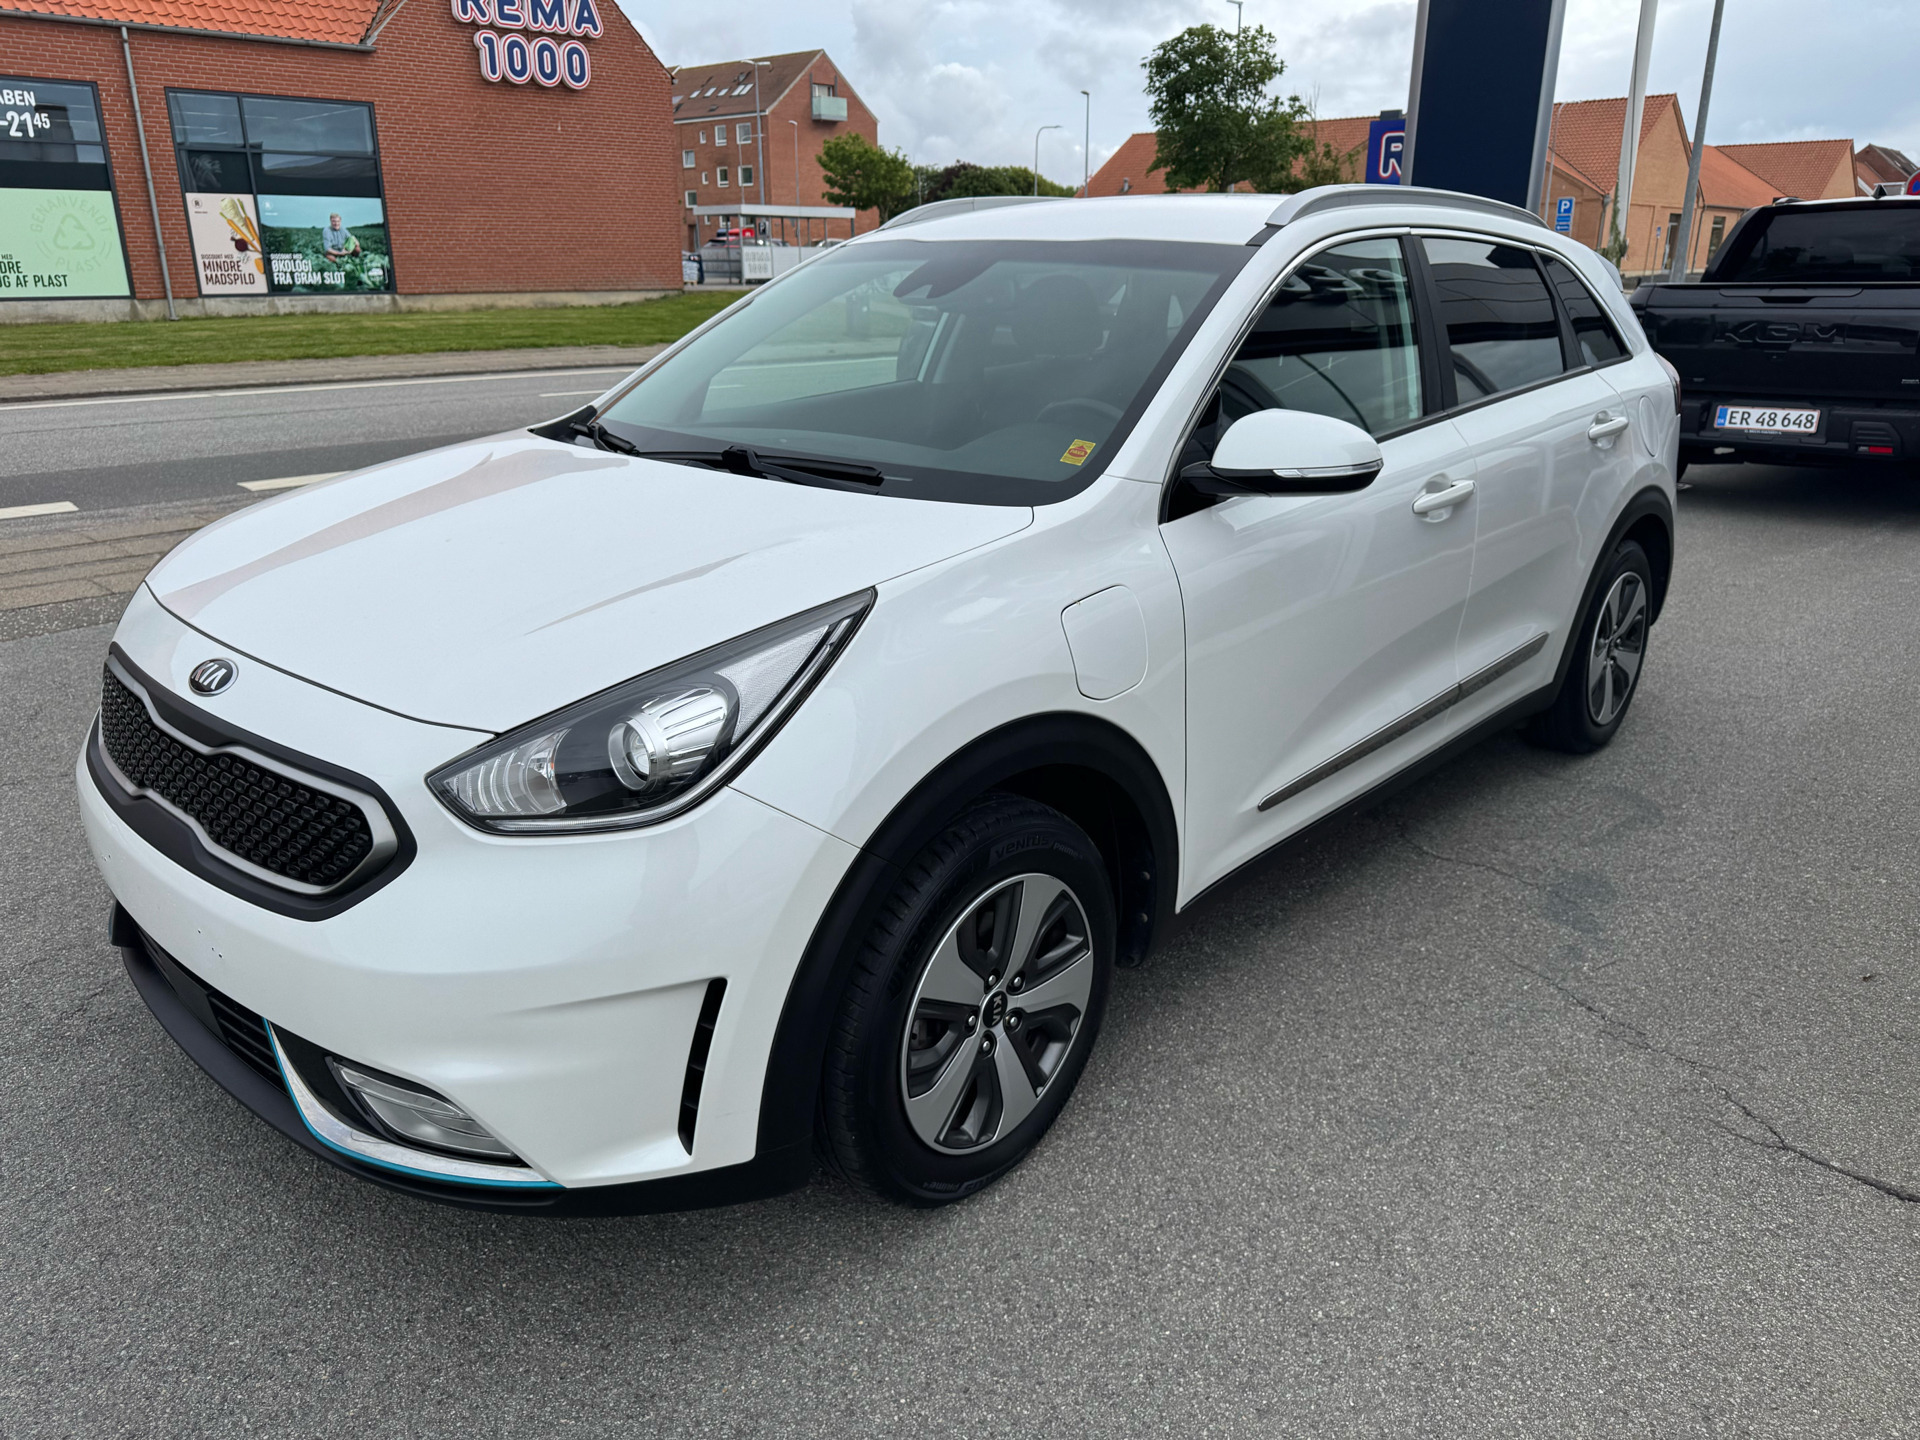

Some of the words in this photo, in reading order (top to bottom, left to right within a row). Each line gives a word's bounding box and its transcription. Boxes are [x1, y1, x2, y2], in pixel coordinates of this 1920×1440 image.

[473, 30, 591, 90] 1000
[1561, 200, 1571, 213] P
[203, 260, 242, 273] MINDRE
[271, 259, 312, 273] ØKOLOGI
[16, 275, 28, 288] AF
[33, 274, 68, 288] PLAST
[205, 273, 256, 286] MADSPILD
[273, 272, 292, 286] FRA
[294, 272, 322, 285] GRAM
[324, 271, 346, 285] SLOT
[1728, 410, 1751, 426] ER
[1756, 411, 1778, 427] 48
[1781, 412, 1815, 430] 648
[190, 660, 228, 691] KIA
